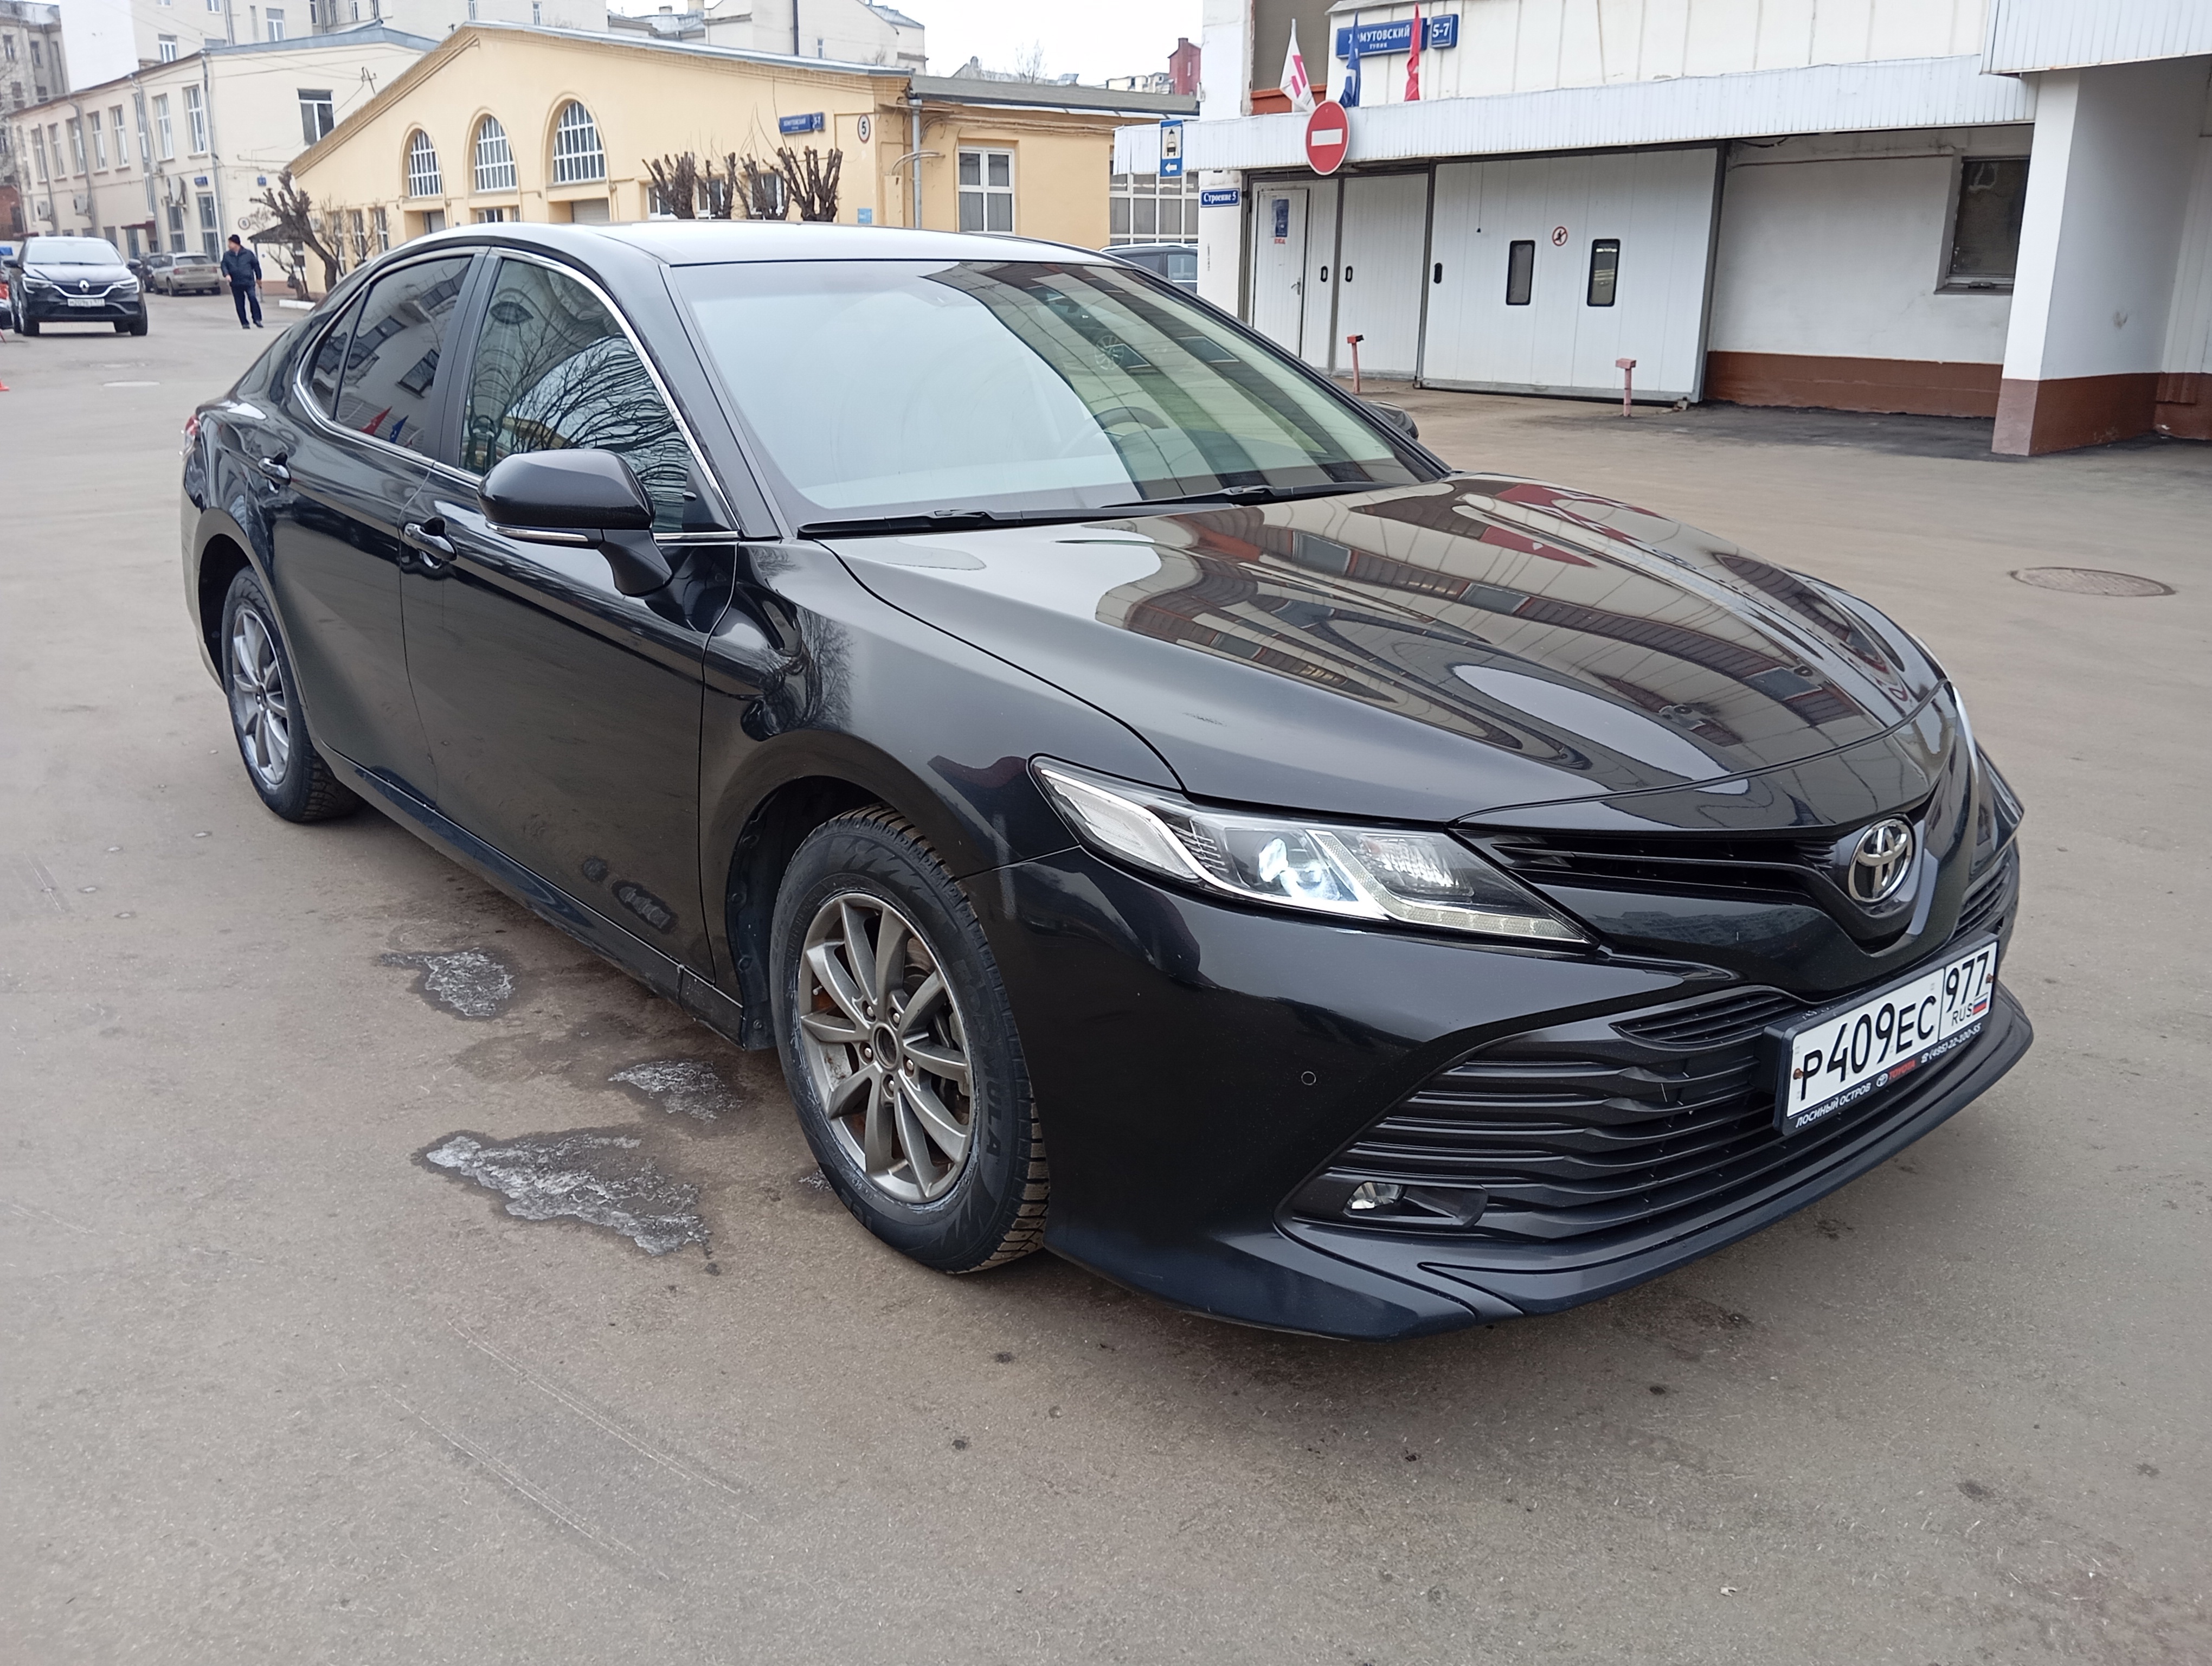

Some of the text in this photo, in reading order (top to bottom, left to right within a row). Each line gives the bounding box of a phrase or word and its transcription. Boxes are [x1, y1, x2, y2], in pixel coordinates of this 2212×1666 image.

[1432, 22, 1450, 38] 5-7
[861, 121, 867, 135] 5
[1204, 191, 1237, 204] Строение 5
[1800, 950, 1989, 1101] Р409ЕС 977
[1951, 1002, 1973, 1027] RUS
[952, 959, 1002, 1157] FORMULA
[1888, 1059, 1916, 1080] TOYOTA
[1795, 1082, 1872, 1128] ЛОСИНЫЙ ОСТРОВ
